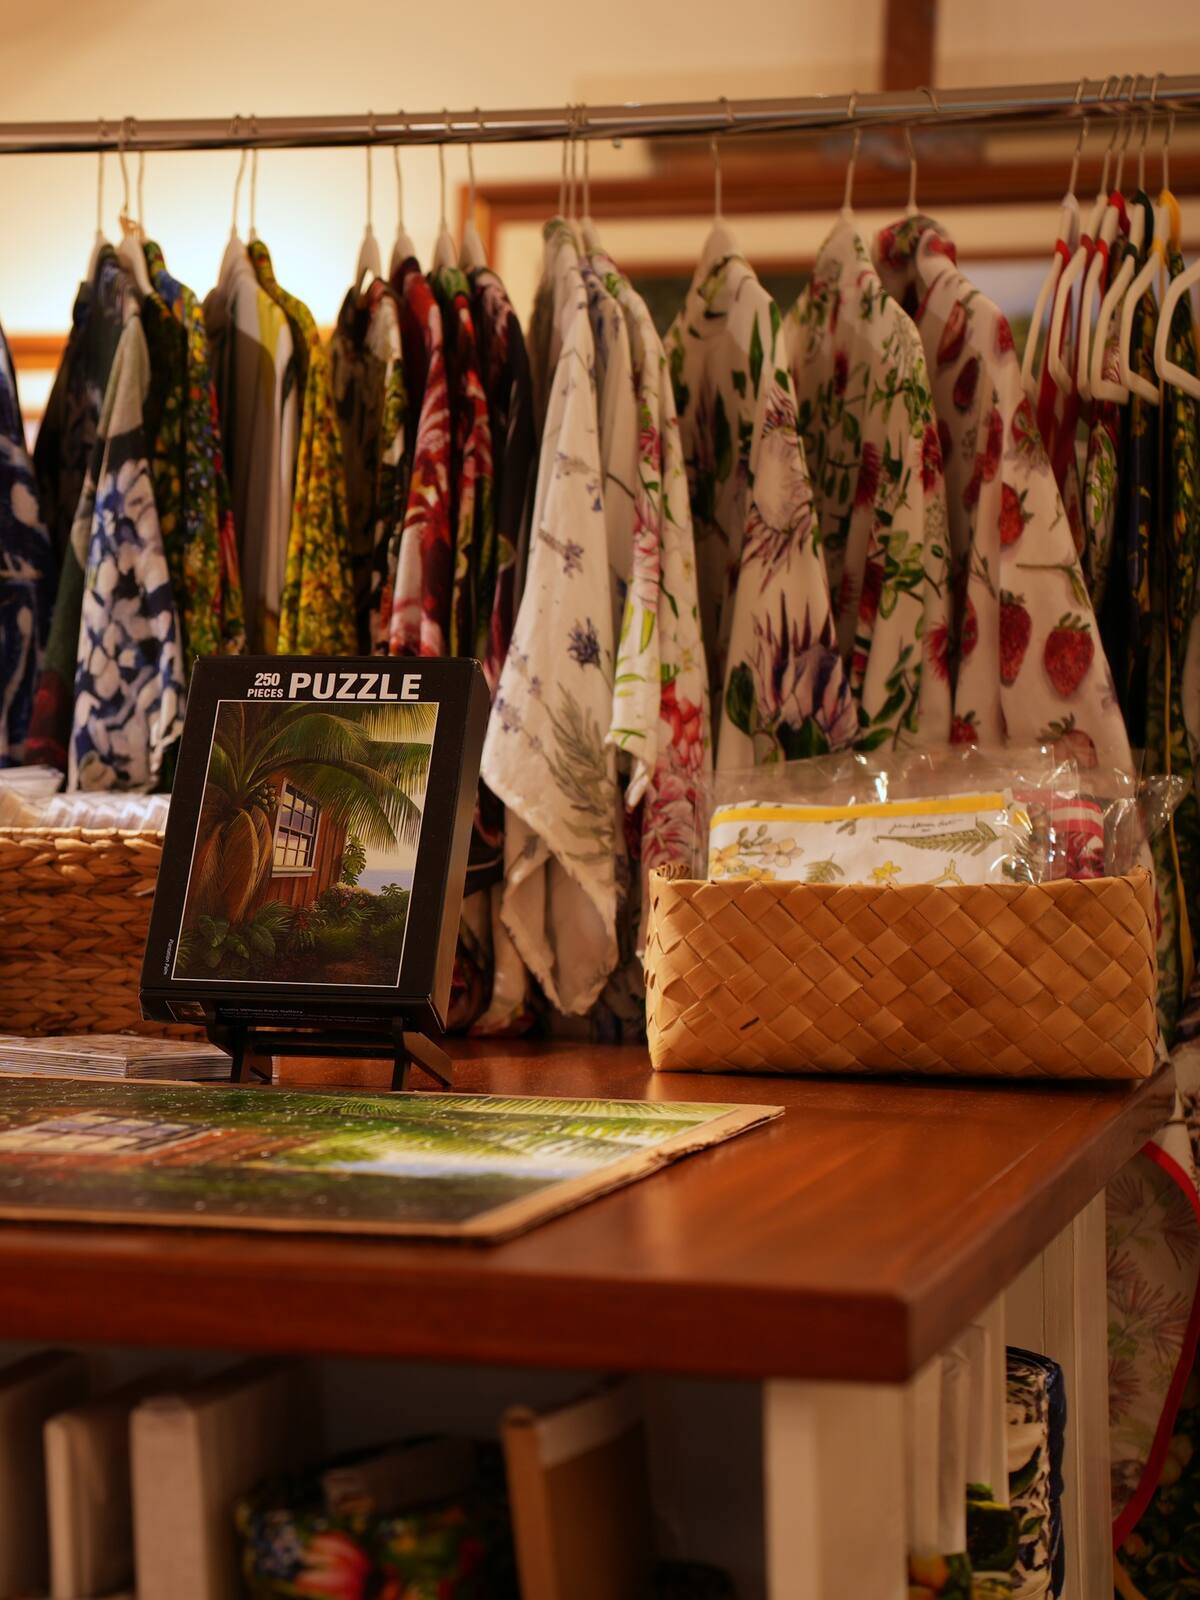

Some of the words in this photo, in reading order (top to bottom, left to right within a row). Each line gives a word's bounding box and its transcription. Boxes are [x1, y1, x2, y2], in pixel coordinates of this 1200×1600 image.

[254, 673, 281, 687] 250
[288, 672, 422, 700] PUZZLE
[247, 688, 284, 698] PIECES
